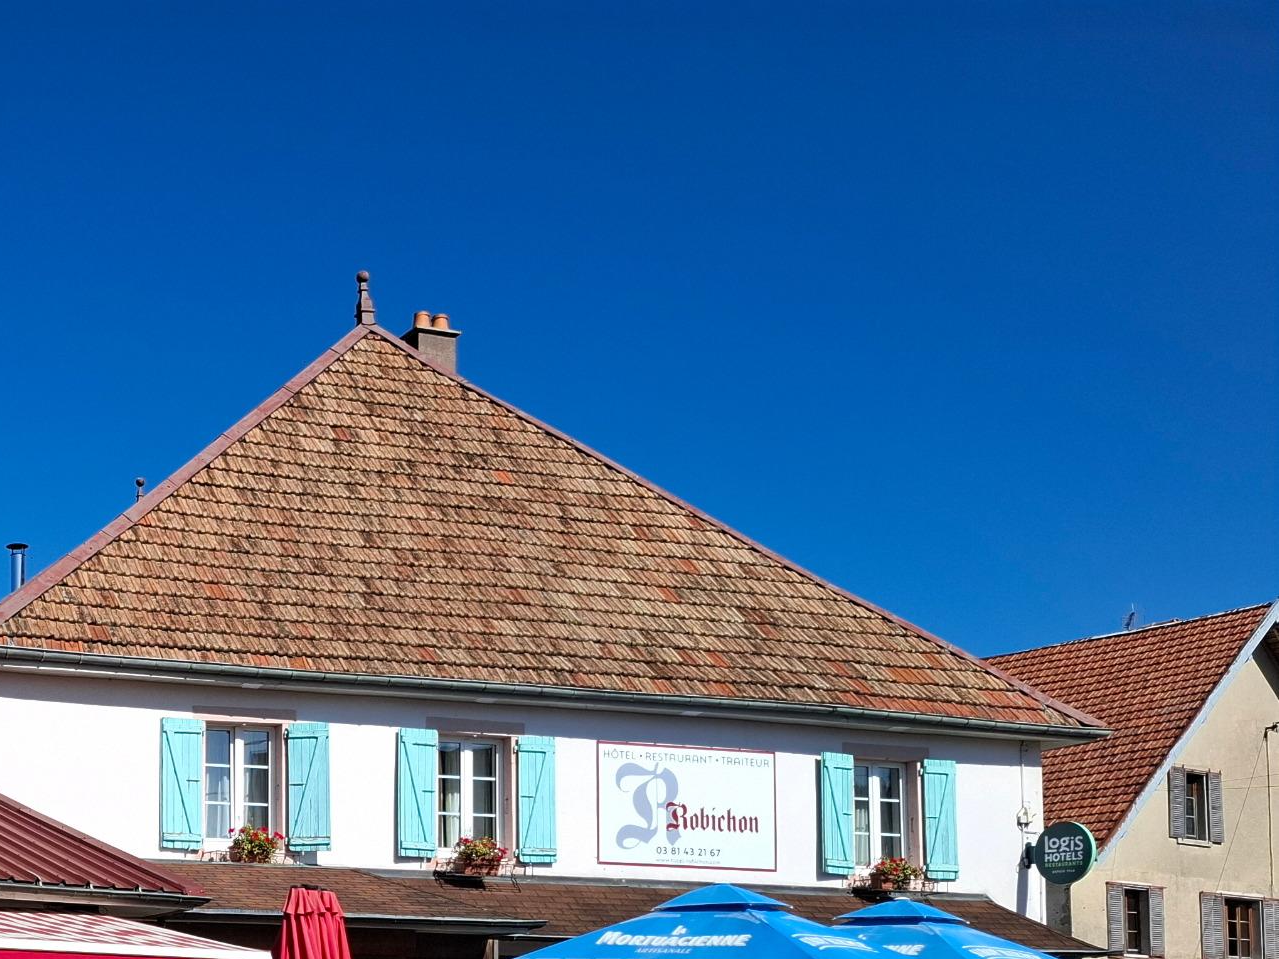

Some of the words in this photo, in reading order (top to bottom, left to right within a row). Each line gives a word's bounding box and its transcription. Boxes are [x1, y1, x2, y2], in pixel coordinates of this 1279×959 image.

[603, 748, 636, 760] HÔTEL
[645, 751, 713, 764] RESTAURANT
[721, 756, 770, 768] TRAITEUR
[665, 801, 759, 833] Robichon
[656, 846, 668, 855] 03
[671, 847, 680, 855] 81
[683, 847, 694, 856] 43
[698, 848, 707, 857] 21
[709, 849, 721, 857] 67
[1044, 851, 1083, 863] HOTELS
